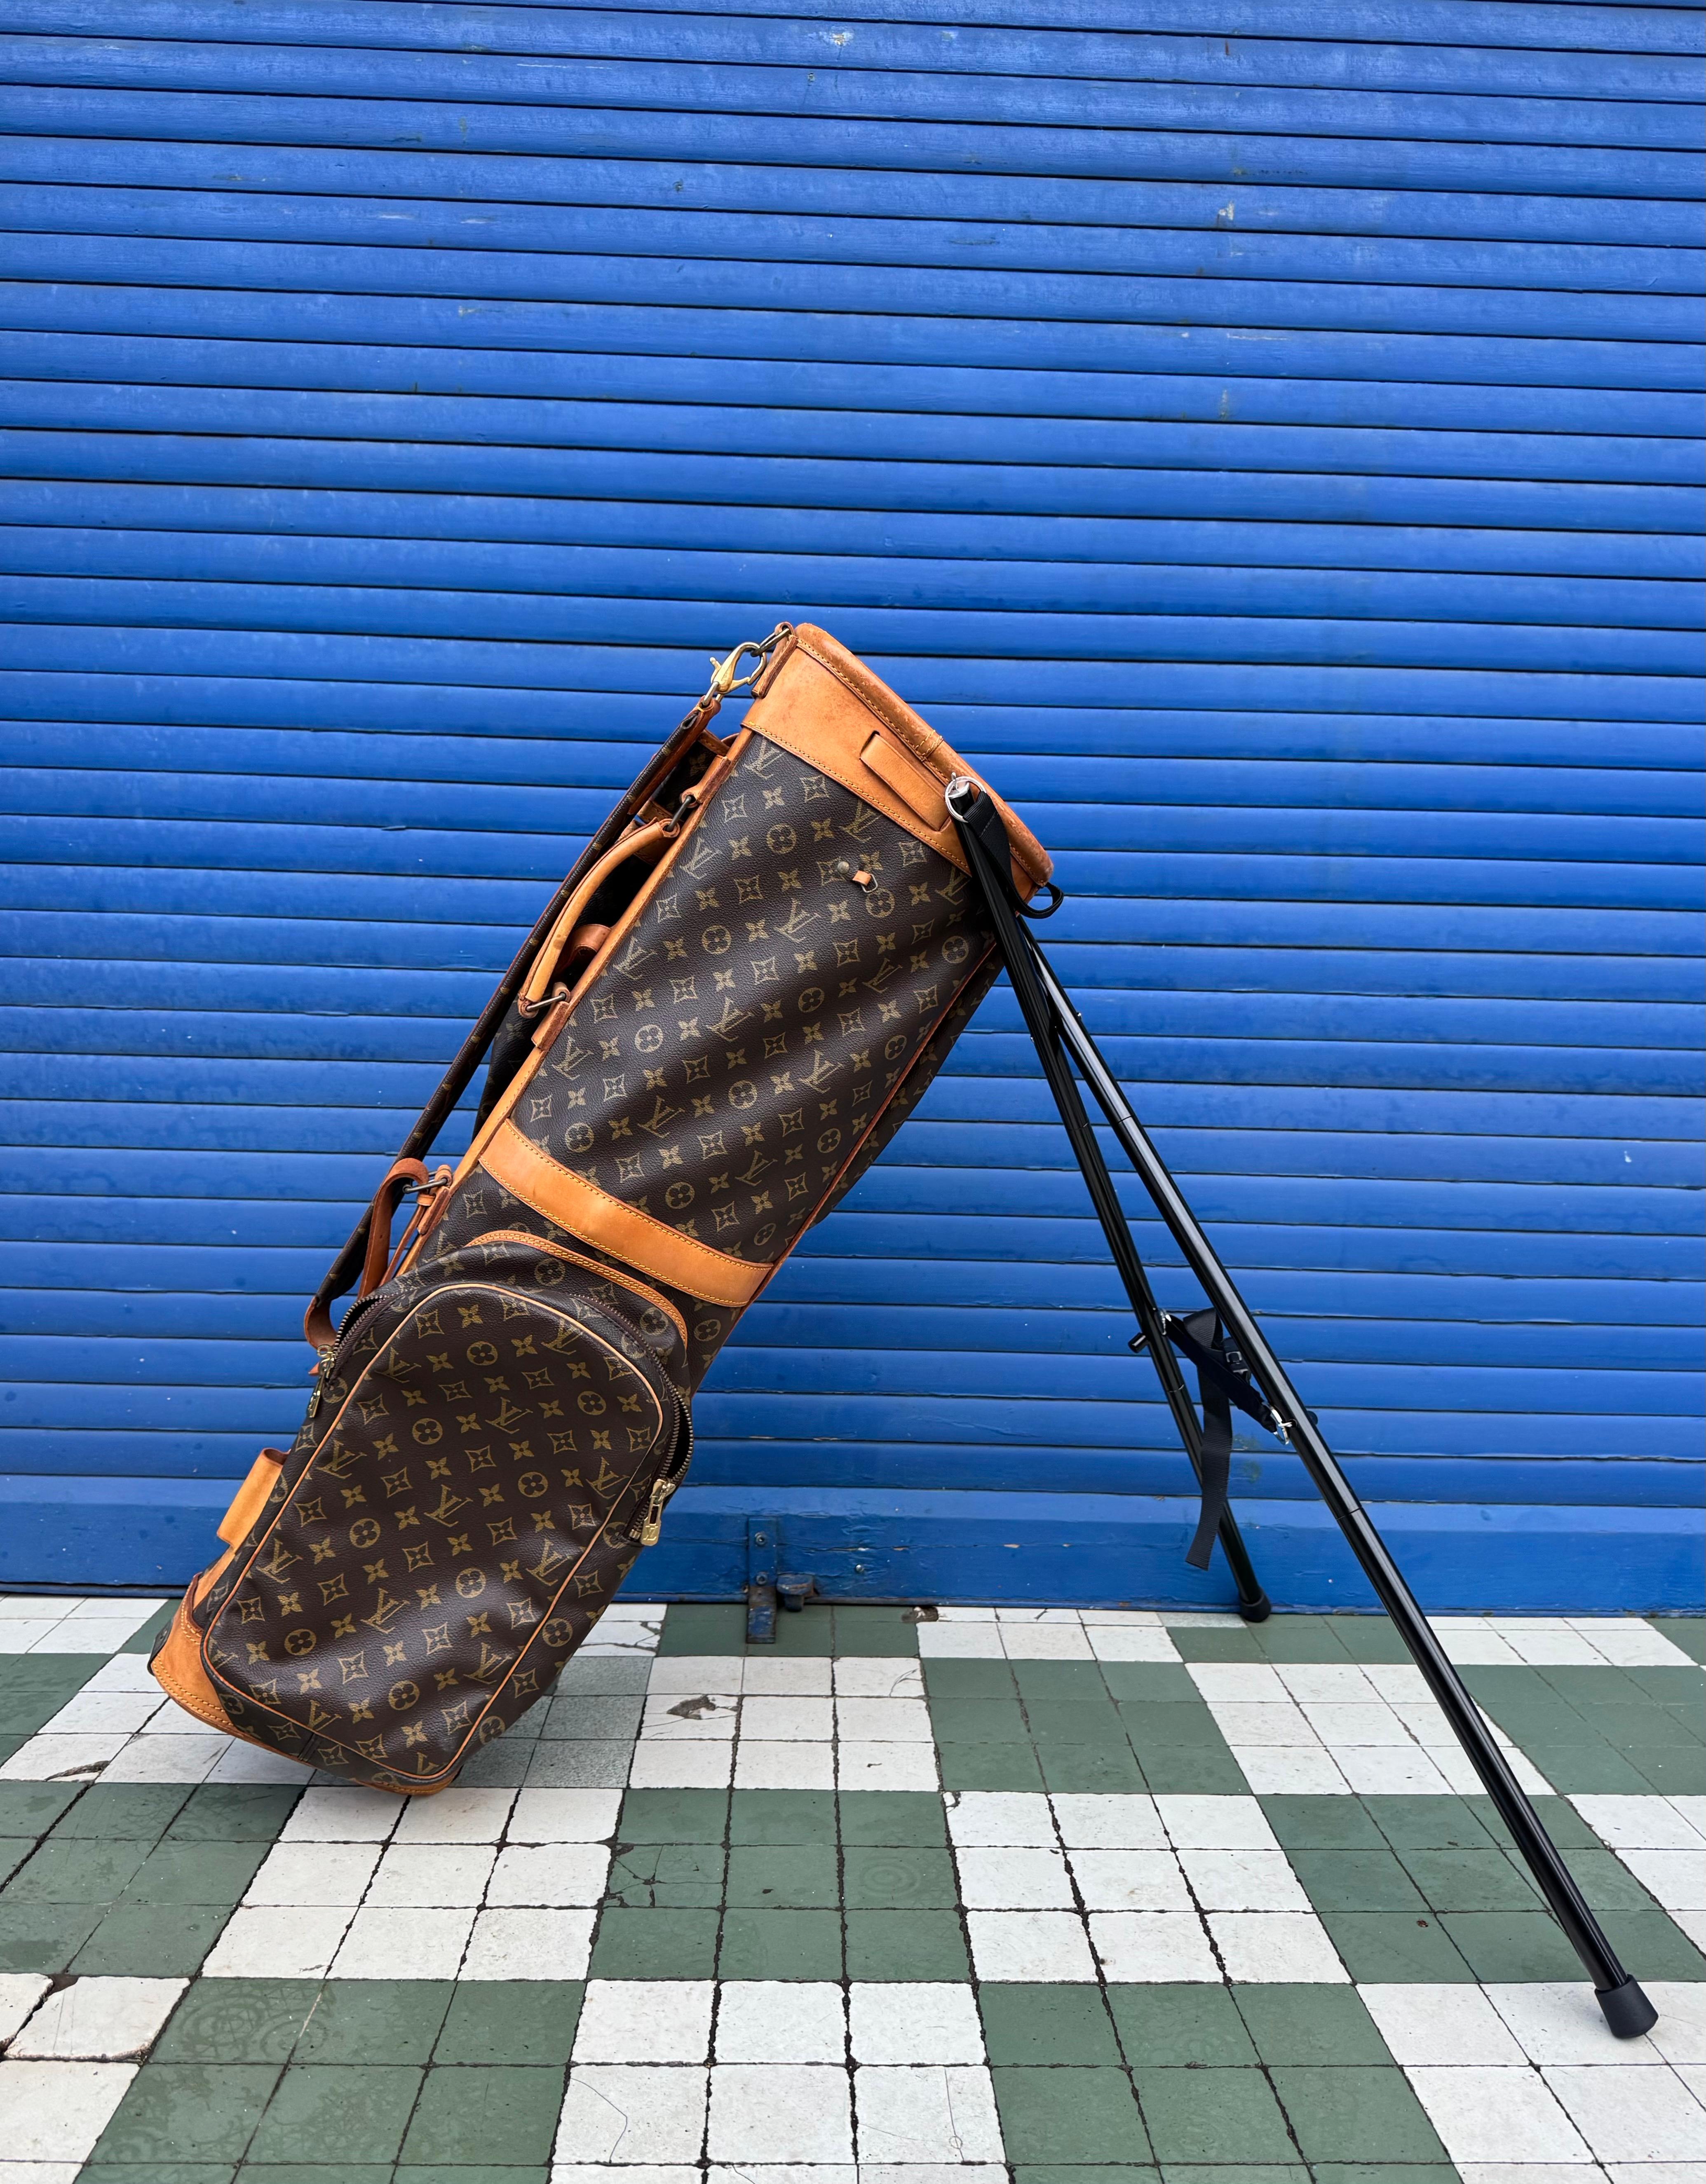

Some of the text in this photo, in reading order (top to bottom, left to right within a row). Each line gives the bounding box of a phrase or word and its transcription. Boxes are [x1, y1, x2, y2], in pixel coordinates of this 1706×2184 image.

[742, 736, 786, 780] LV
[839, 801, 881, 843] LV
[680, 836, 722, 879] LV
[936, 867, 971, 905] LV
[773, 898, 821, 943] LV
[612, 935, 657, 980] LV
[862, 958, 903, 993] LV
[706, 997, 755, 1042] LV
[552, 1036, 594, 1080] LV
[799, 1049, 843, 1093] LV
[637, 1095, 685, 1138] LV
[735, 1150, 778, 1186] LV
[541, 1318, 583, 1355] LV
[374, 1347, 422, 1383] LV
[485, 1397, 533, 1434] LV
[315, 1439, 367, 1479] LV
[586, 1456, 630, 1499] LV
[423, 1484, 474, 1527] LV
[643, 1525, 659, 1541] LV
[256, 1538, 303, 1584] LV
[526, 1539, 573, 1586] LV
[360, 1587, 410, 1634] LV
[463, 1642, 512, 1685] LV
